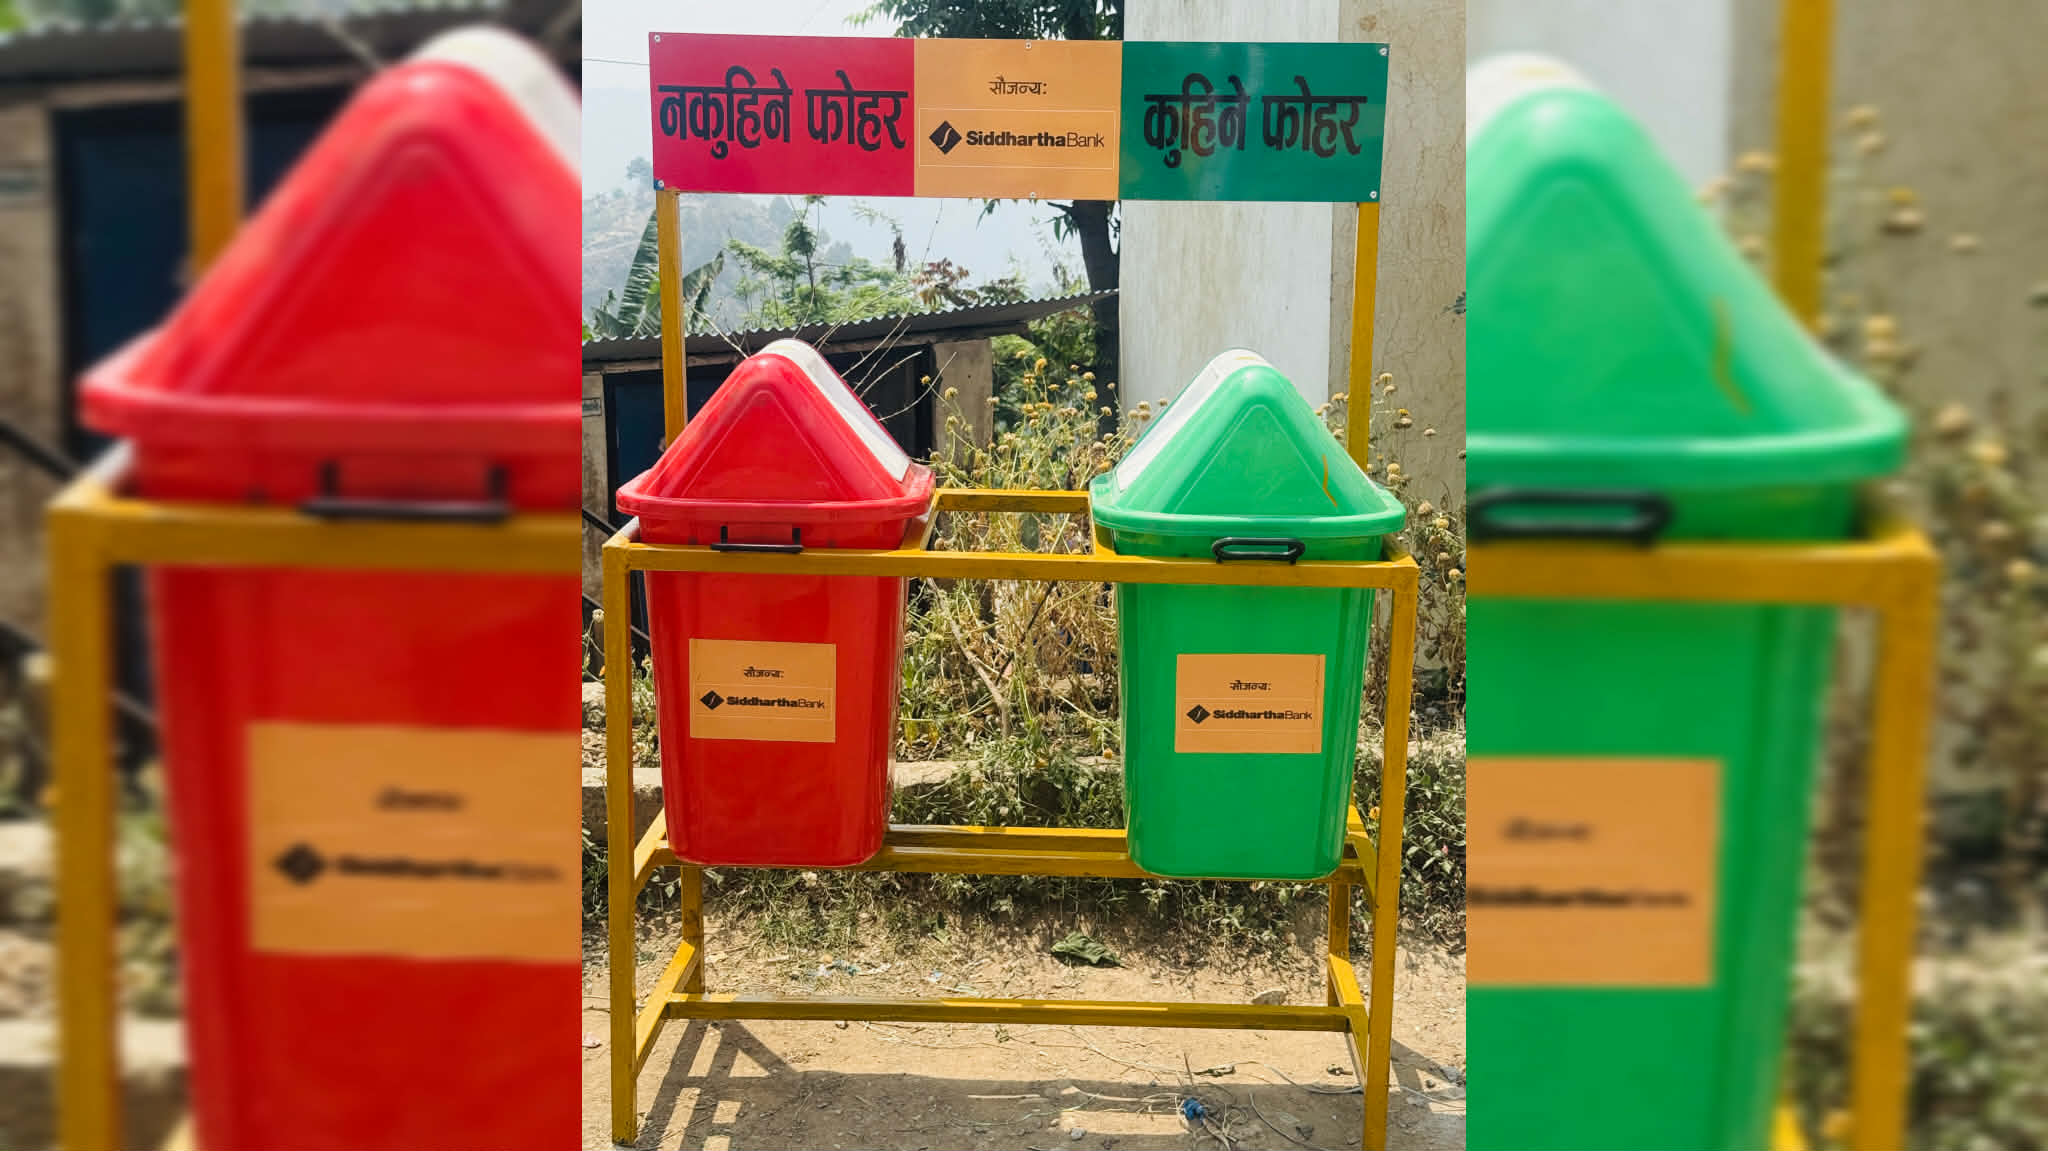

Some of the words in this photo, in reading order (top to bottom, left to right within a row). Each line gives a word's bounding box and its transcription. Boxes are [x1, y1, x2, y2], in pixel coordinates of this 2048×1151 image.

[658, 65, 793, 160] नकुहिने
[805, 69, 908, 151] फोहर
[1143, 73, 1251, 168] कुहिने
[1262, 75, 1368, 158] फोहर
